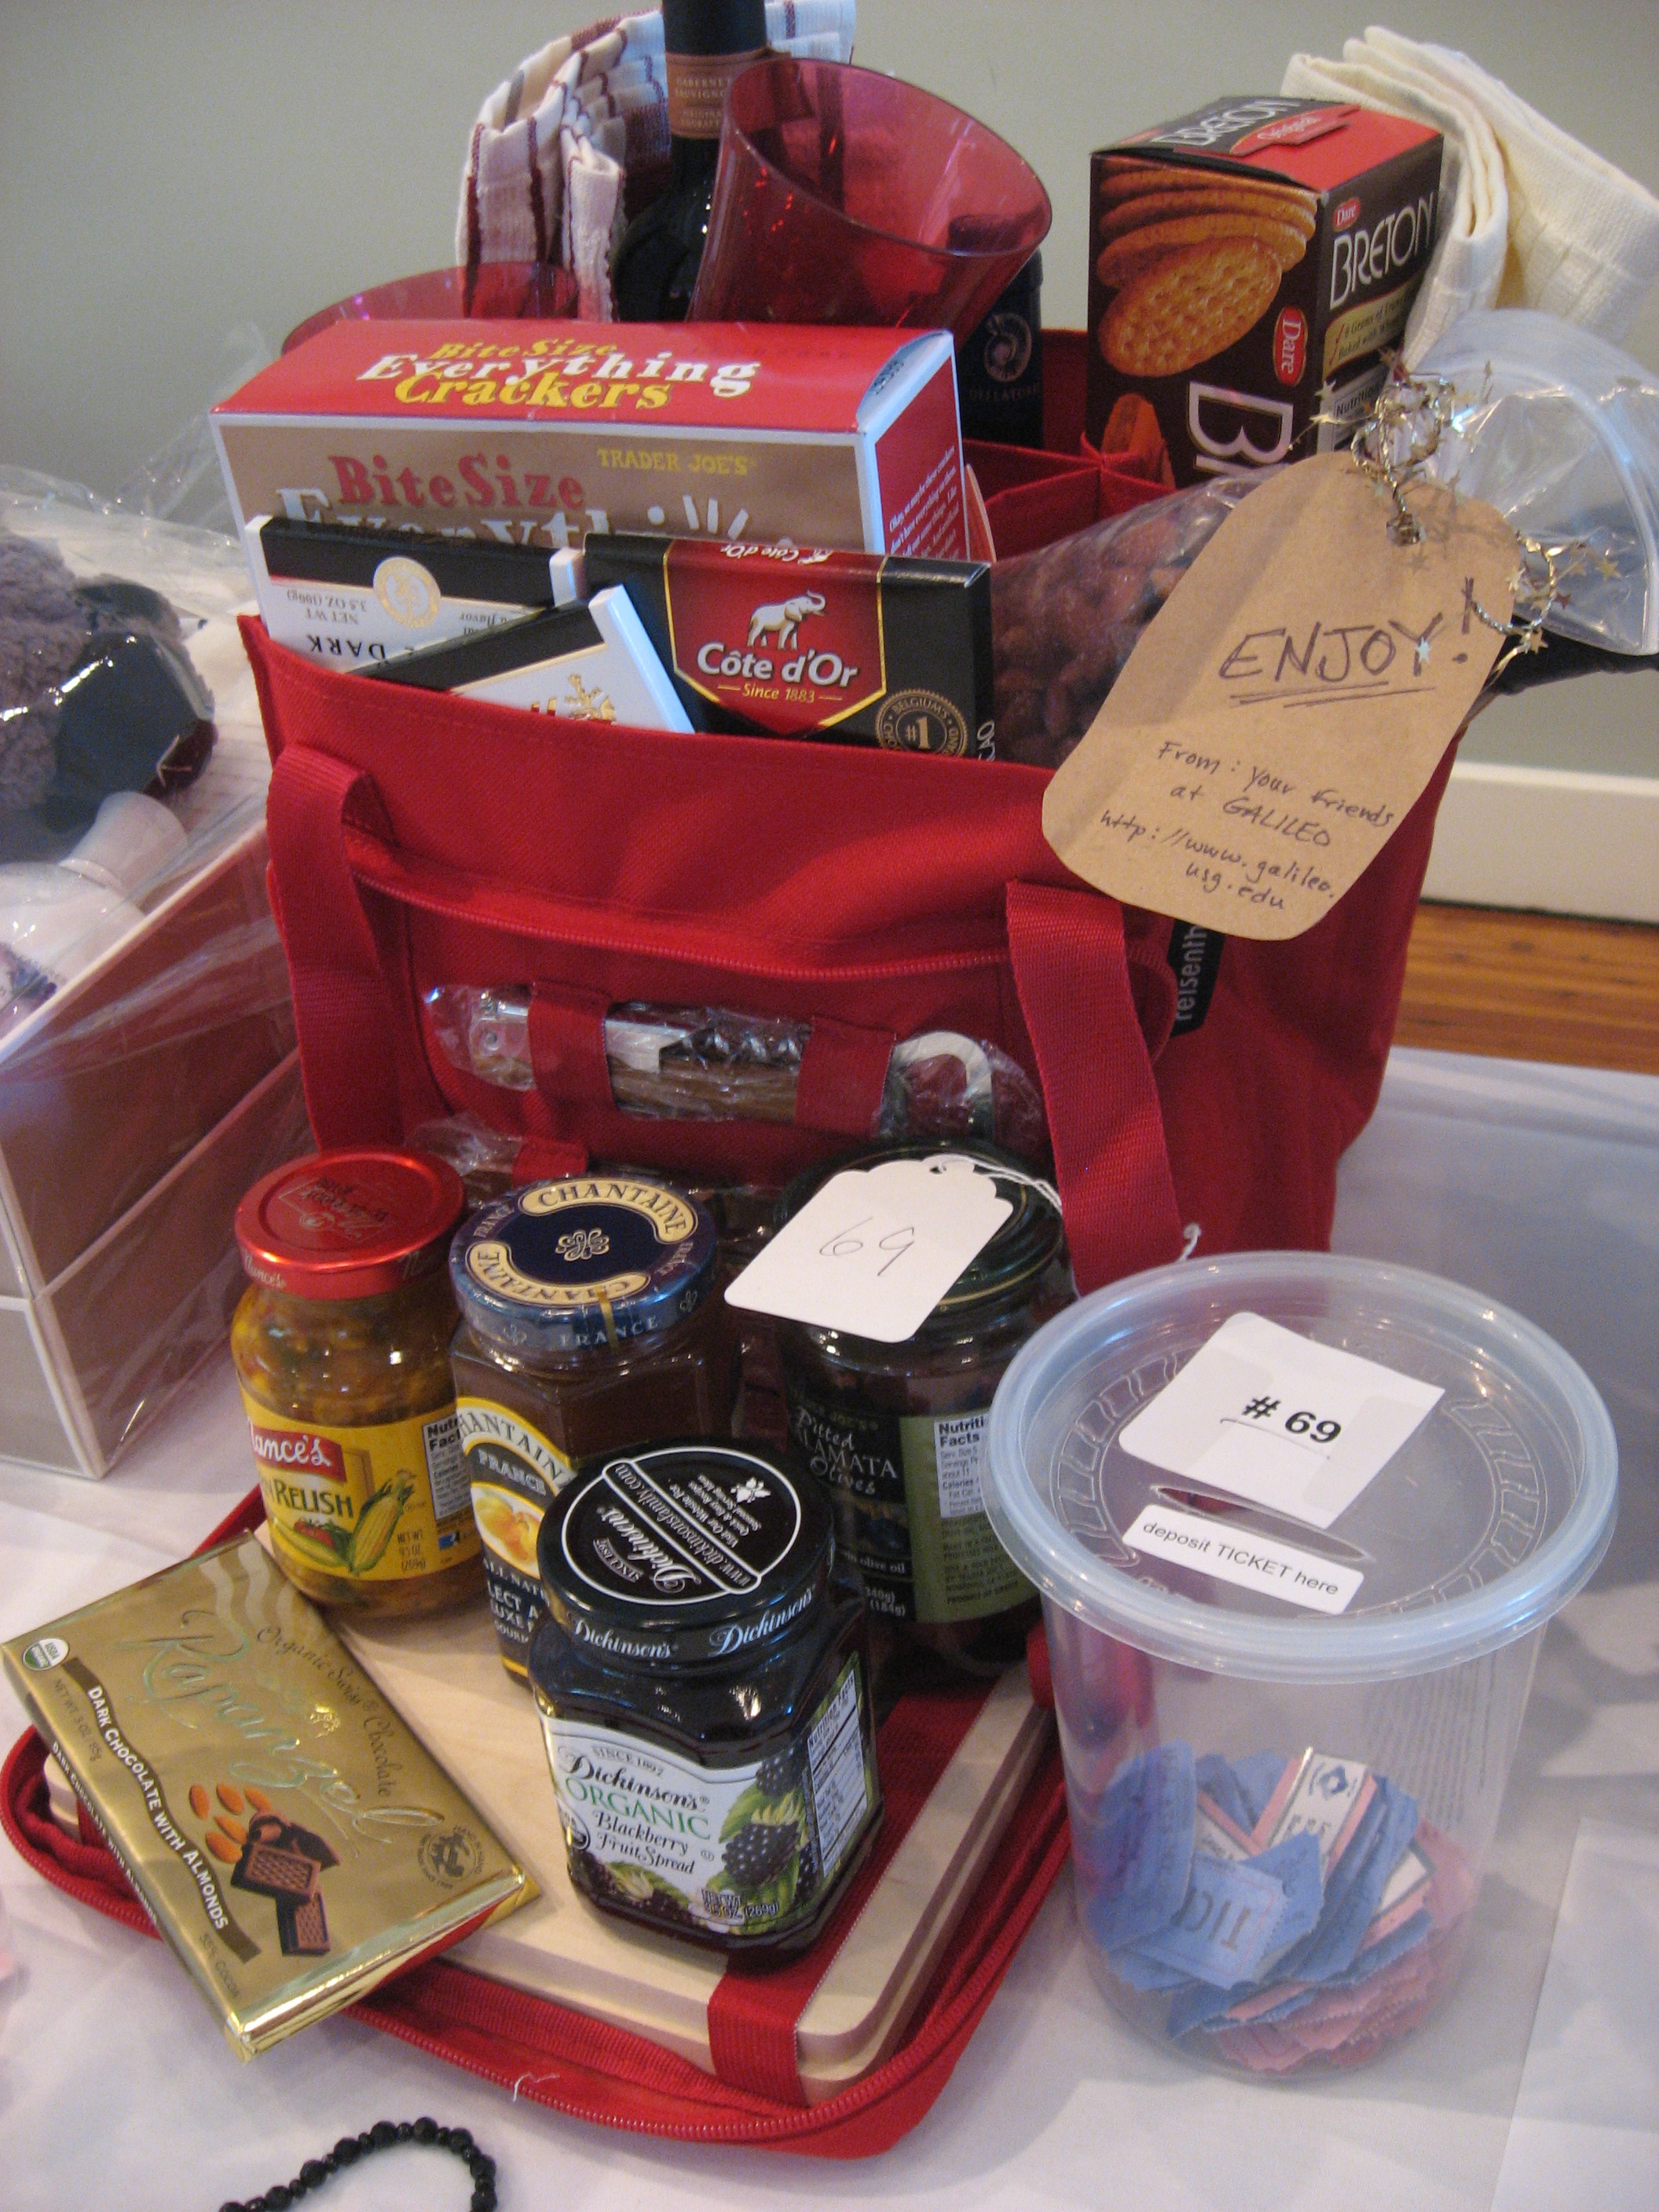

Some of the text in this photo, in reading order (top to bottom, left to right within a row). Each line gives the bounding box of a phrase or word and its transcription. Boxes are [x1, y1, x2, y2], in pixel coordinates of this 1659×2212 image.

[1336, 204, 1357, 225] Dare
[1330, 192, 1437, 310] BRETON
[427, 338, 618, 361] Bite Size
[1278, 317, 1302, 375] Dare
[356, 351, 760, 398] Everything
[394, 371, 672, 410] Crackers
[327, 451, 587, 511] Bite Size
[598, 447, 749, 477] TRADER JOE'S
[305, 634, 387, 663] DARK
[696, 641, 861, 688] Côte d'Or
[742, 683, 816, 705] Since 1883
[905, 716, 932, 749] #1
[1170, 785, 1331, 848] at GALILEO
[538, 1182, 688, 1235] CHANTAINE
[819, 1217, 916, 1277] 69
[559, 1314, 660, 1348] FRANCE
[939, 1416, 987, 1436] Nutriti
[939, 1432, 981, 1448] Facts
[1284, 1411, 1342, 1445] 69
[478, 1448, 547, 1496] FRANCE
[810, 1456, 877, 1496] Olives
[274, 1478, 354, 1519] RELISH
[613, 1463, 752, 1588] www.dickinsonsfamily.com
[600, 1505, 701, 1594] Dickinson's
[860, 1554, 888, 1571] olive
[889, 1562, 906, 1575] oil
[1142, 1522, 1339, 1595] deposit TICKET here
[573, 1618, 672, 1659] Dickinson's
[364, 1716, 402, 1797] Chocolate
[558, 1749, 699, 1811] Dickinson's
[52, 1741, 71, 1774] DARK
[71, 1772, 107, 1836] CHOCOLATE
[107, 1837, 126, 1869] WITH
[86, 1685, 229, 1931] DARK CHOCOLATE WITH ALMONDS
[565, 1777, 712, 1840] ORGANIC
[591, 1810, 689, 1856] Blackberry
[597, 1831, 696, 1875] Fruit Spread
